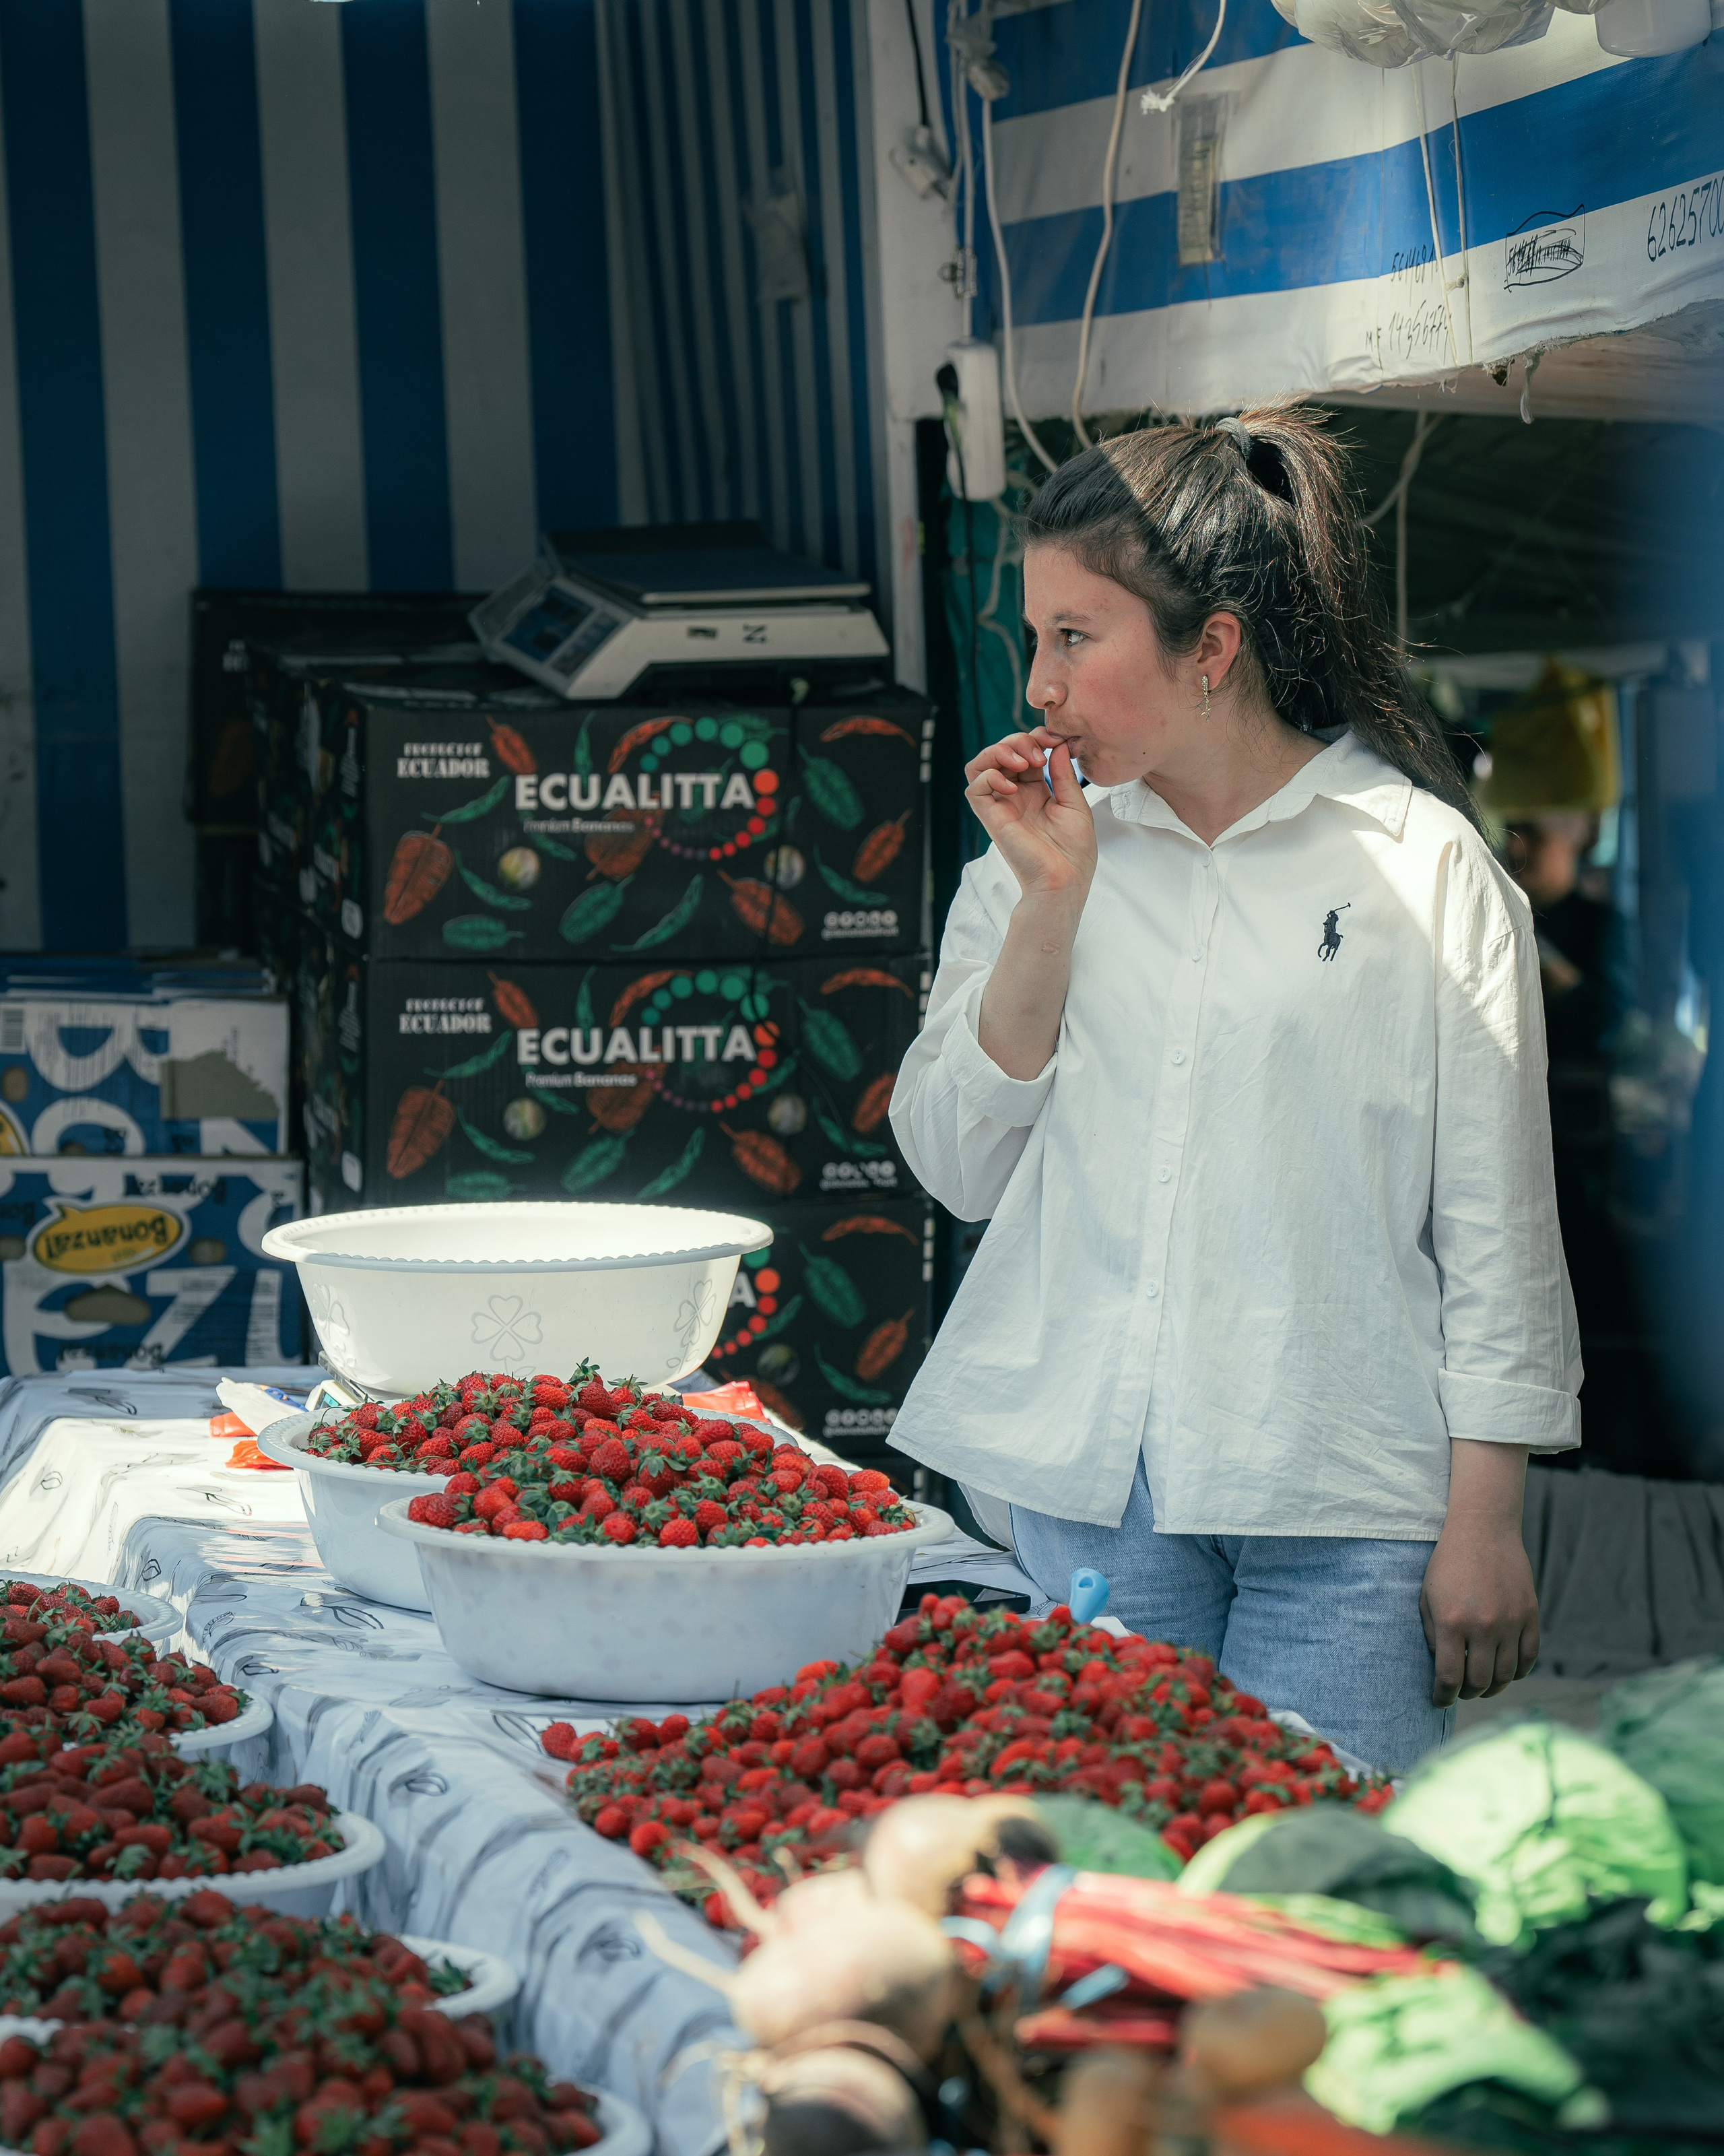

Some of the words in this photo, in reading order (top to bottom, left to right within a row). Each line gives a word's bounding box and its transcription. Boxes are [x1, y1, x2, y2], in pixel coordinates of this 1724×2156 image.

[397, 757, 491, 779] ECUADOR
[515, 773, 756, 811] ECUALITTA
[399, 1013, 492, 1034] ECUADOR
[517, 1026, 756, 1065] ECUALITTA
[45, 1215, 168, 1257] Bonanza!
